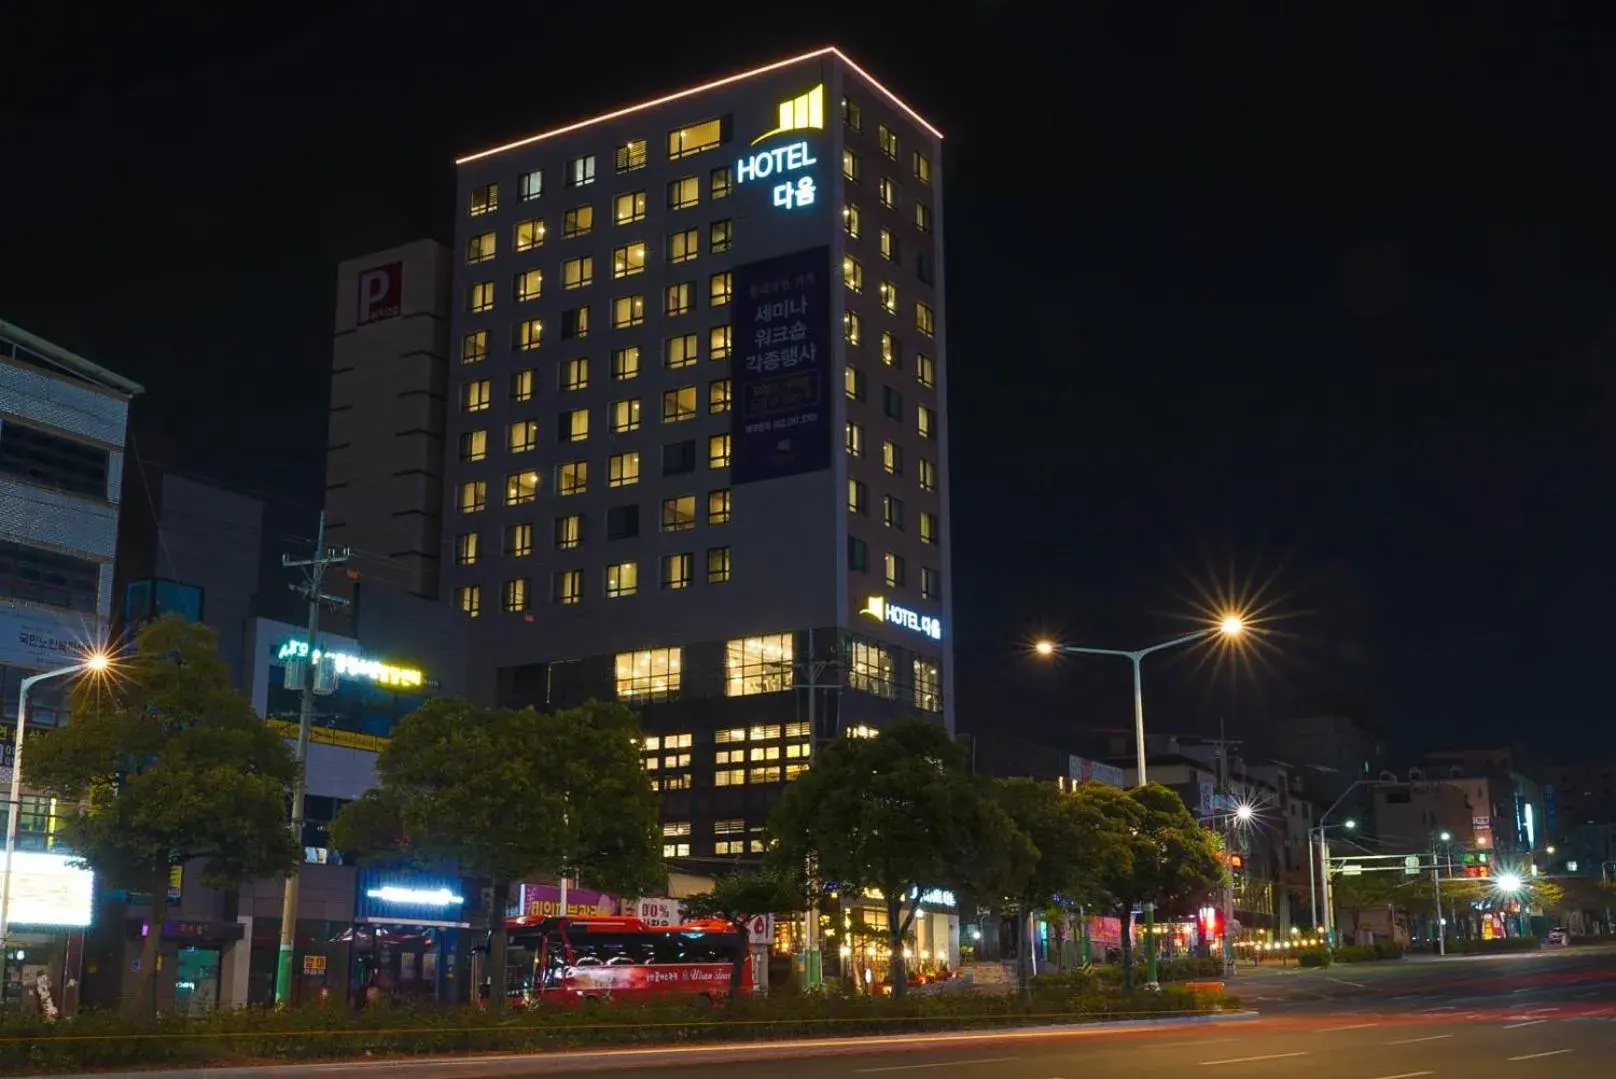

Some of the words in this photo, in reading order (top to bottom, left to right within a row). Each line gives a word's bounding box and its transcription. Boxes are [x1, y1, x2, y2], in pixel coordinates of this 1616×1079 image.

[738, 141, 817, 183] HOTEL
[754, 294, 808, 322] 세미나
[754, 319, 807, 349] 워크숍
[885, 602, 922, 632] HOTEL
